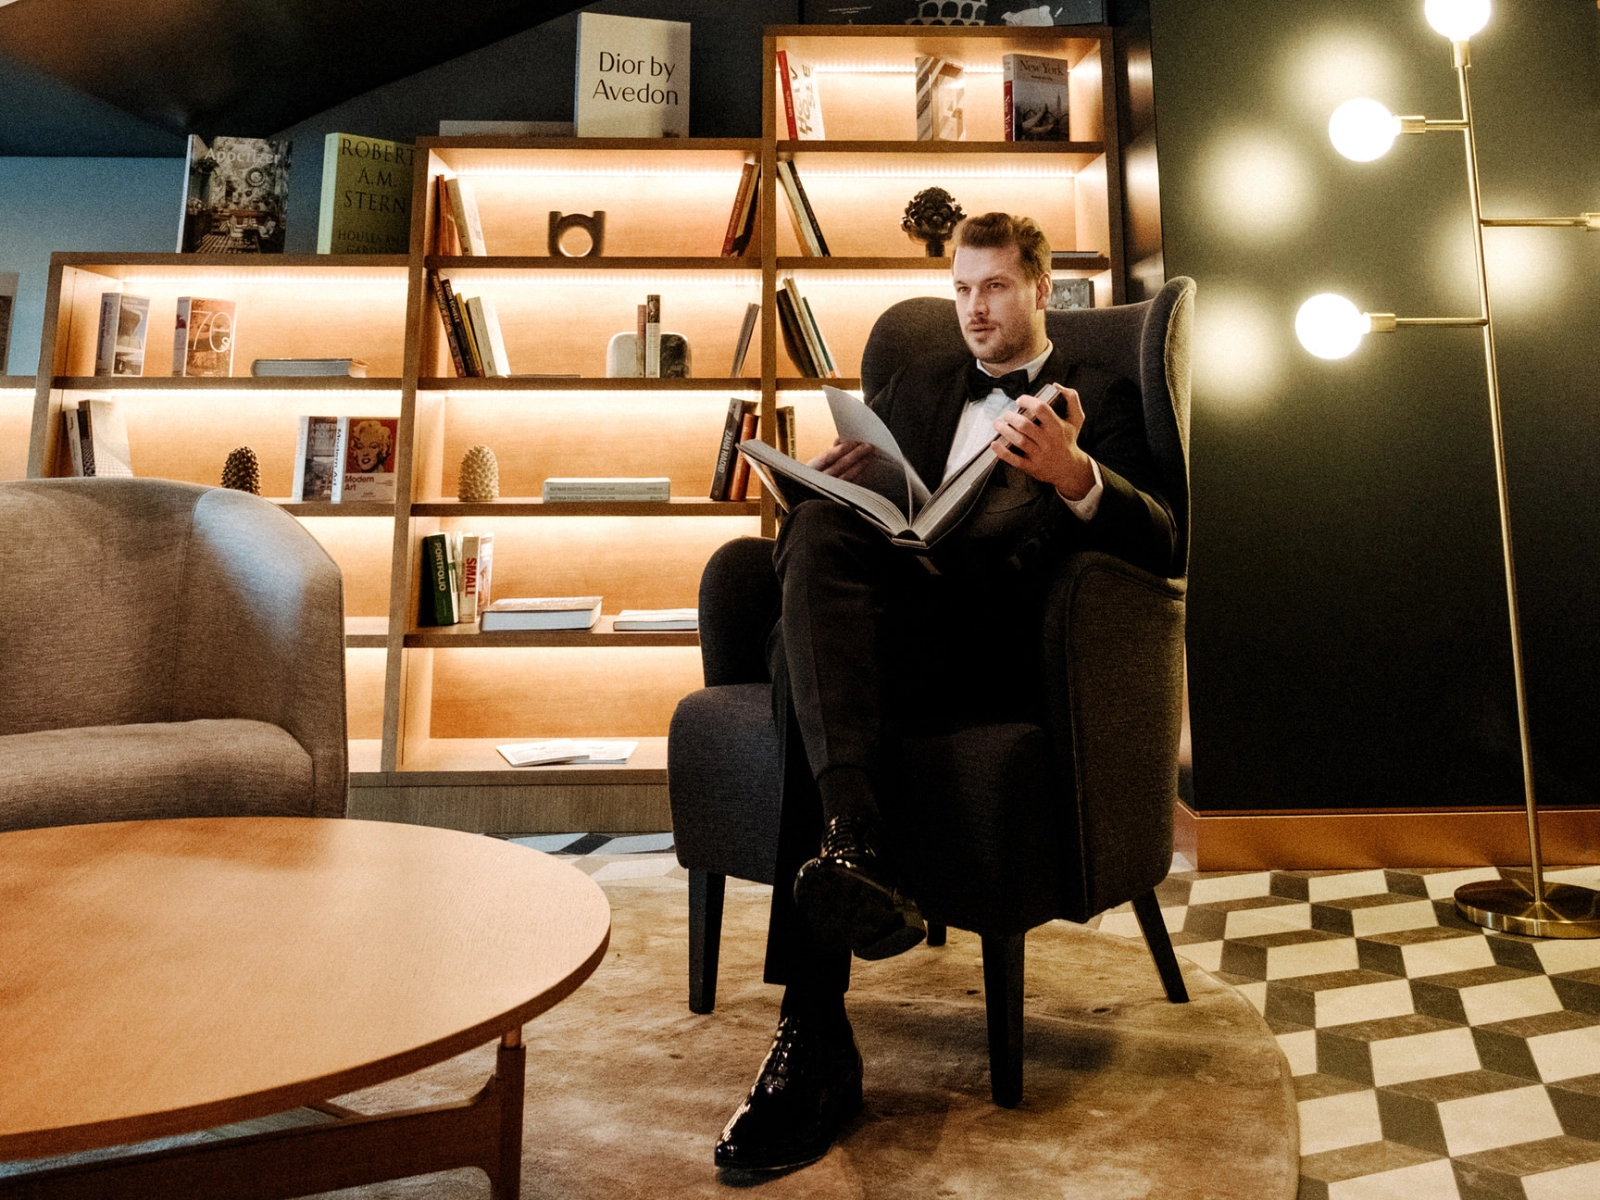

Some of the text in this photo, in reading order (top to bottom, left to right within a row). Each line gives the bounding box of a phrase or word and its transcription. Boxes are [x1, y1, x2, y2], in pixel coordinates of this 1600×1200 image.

[599, 51, 676, 83] Dior by
[1020, 59, 1040, 73] New
[1041, 62, 1065, 76] York
[592, 79, 679, 106] Avedon
[341, 138, 415, 167] ROBERT
[343, 189, 407, 214] STERN
[718, 429, 733, 474] ZAHA HADID
[344, 475, 375, 483] Modern
[344, 483, 357, 491] Art
[434, 542, 447, 591] PORTFOLIO
[465, 557, 477, 598] SMALL
